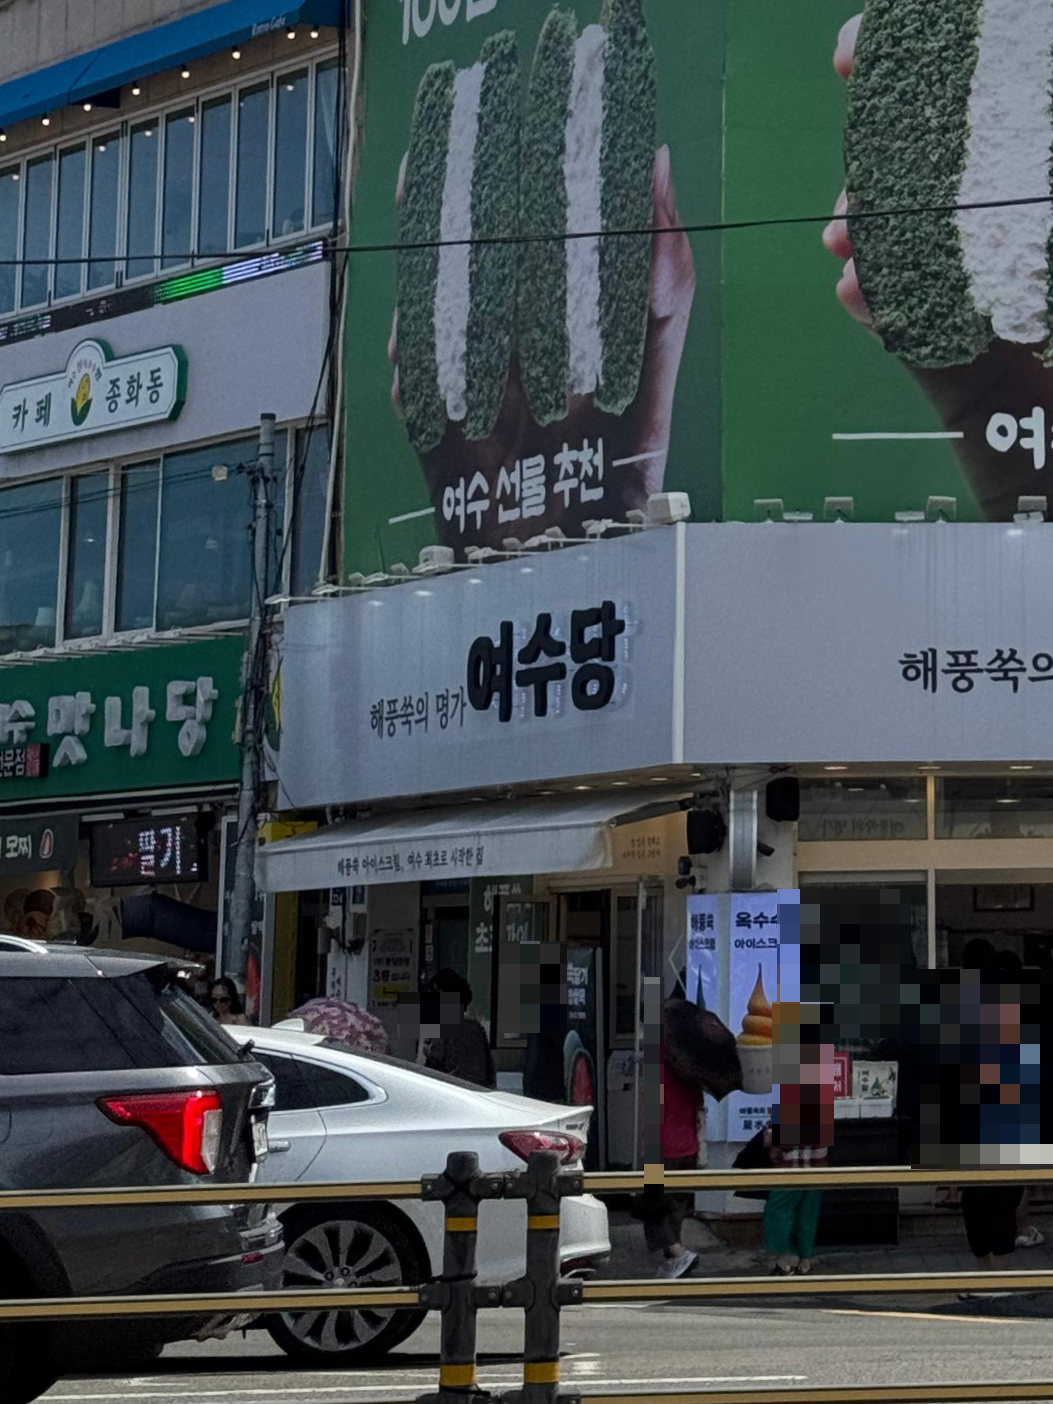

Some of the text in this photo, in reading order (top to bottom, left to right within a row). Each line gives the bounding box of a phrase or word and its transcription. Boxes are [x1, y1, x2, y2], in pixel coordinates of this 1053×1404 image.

[12, 392, 52, 433] 카페
[105, 367, 163, 414] 종화동
[443, 437, 604, 534] 여수 선물 추천
[370, 600, 626, 739] 해풍쑥의 명가 여수당
[0, 748, 25, 777] 문점
[0, 834, 33, 860] 모찌
[407, 851, 422, 870] 여수
[733, 937, 777, 951] 아이스크
